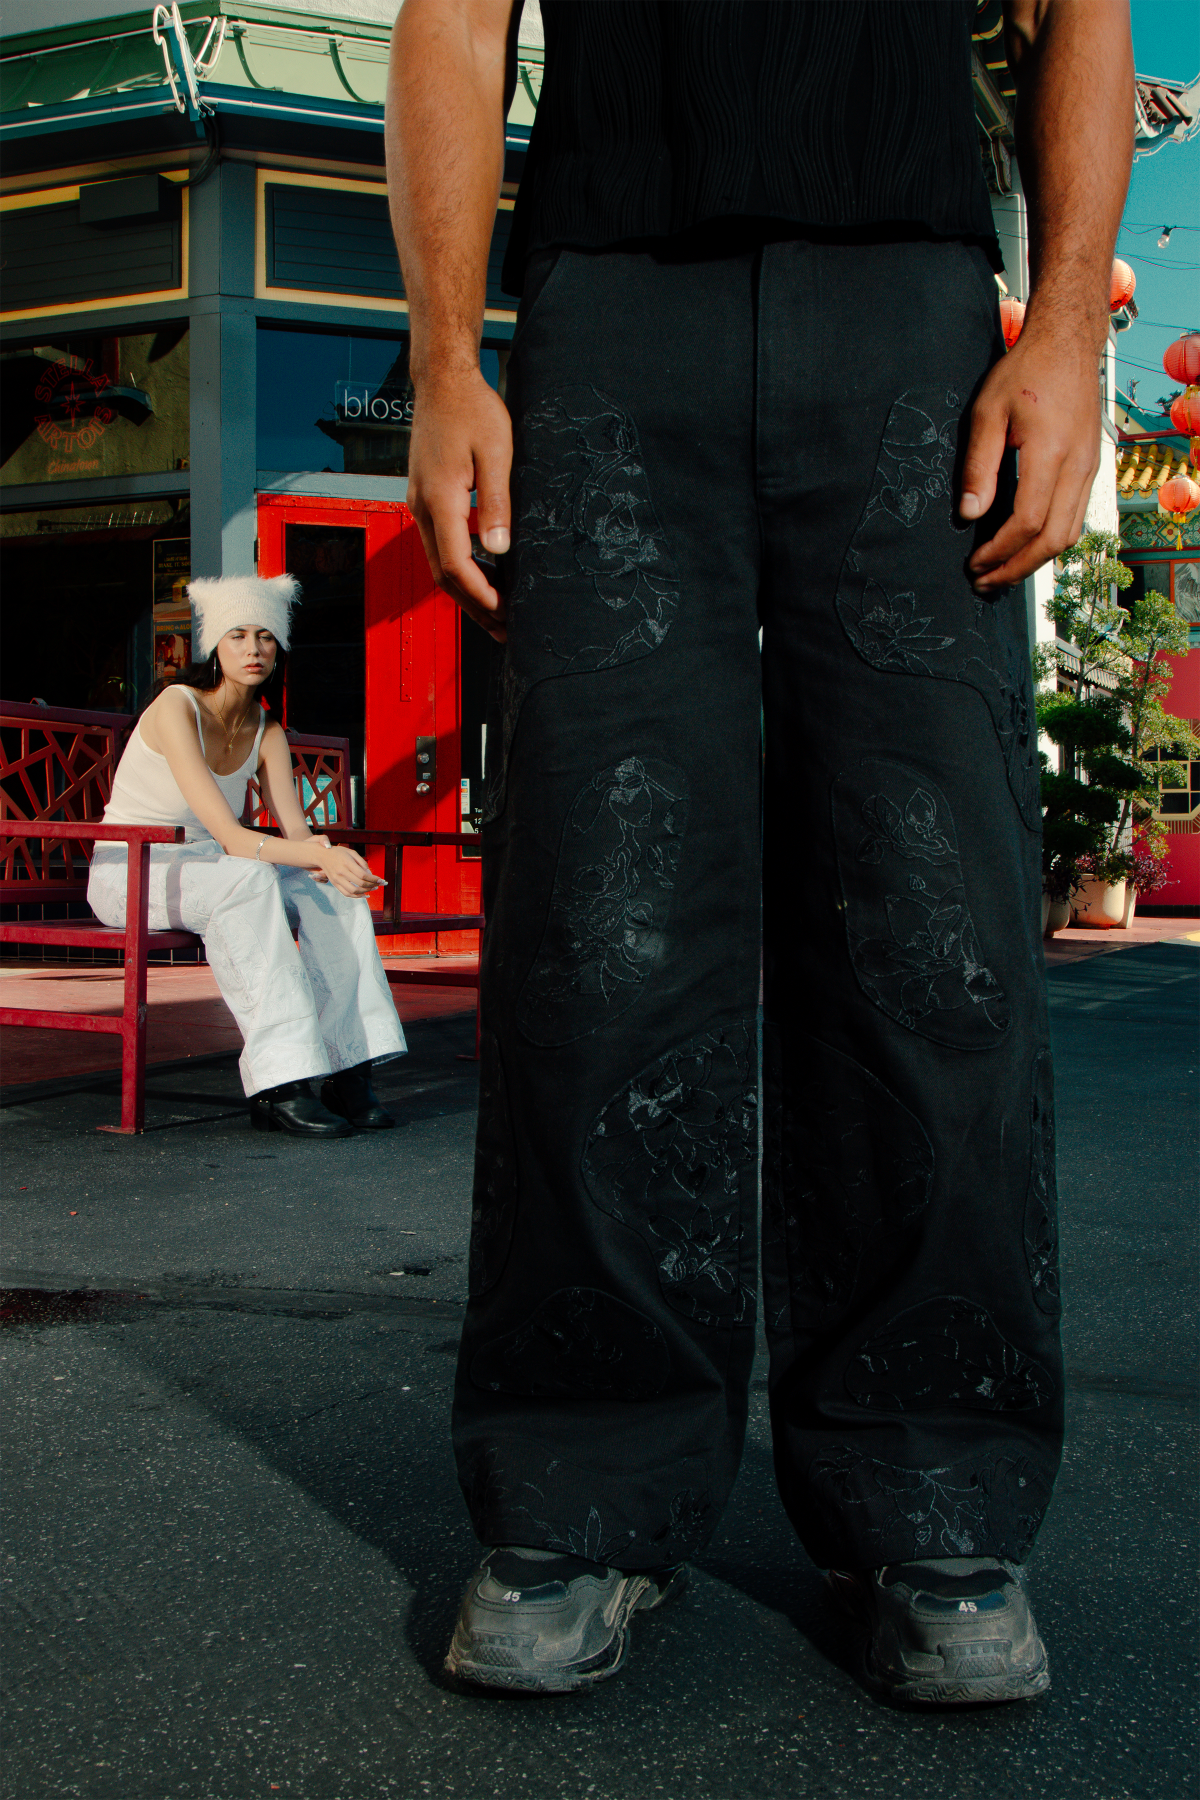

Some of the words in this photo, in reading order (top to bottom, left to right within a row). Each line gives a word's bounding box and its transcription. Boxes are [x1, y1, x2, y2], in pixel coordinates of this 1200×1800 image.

[35, 355, 110, 403] STELLA
[345, 389, 414, 421] bloss
[34, 406, 112, 453] ARTOIS
[48, 458, 99, 475] Chinatown
[156, 624, 175, 632] BRING
[474, 817, 483, 825] 12
[502, 1590, 522, 1603] 45
[958, 1600, 978, 1613] 45
